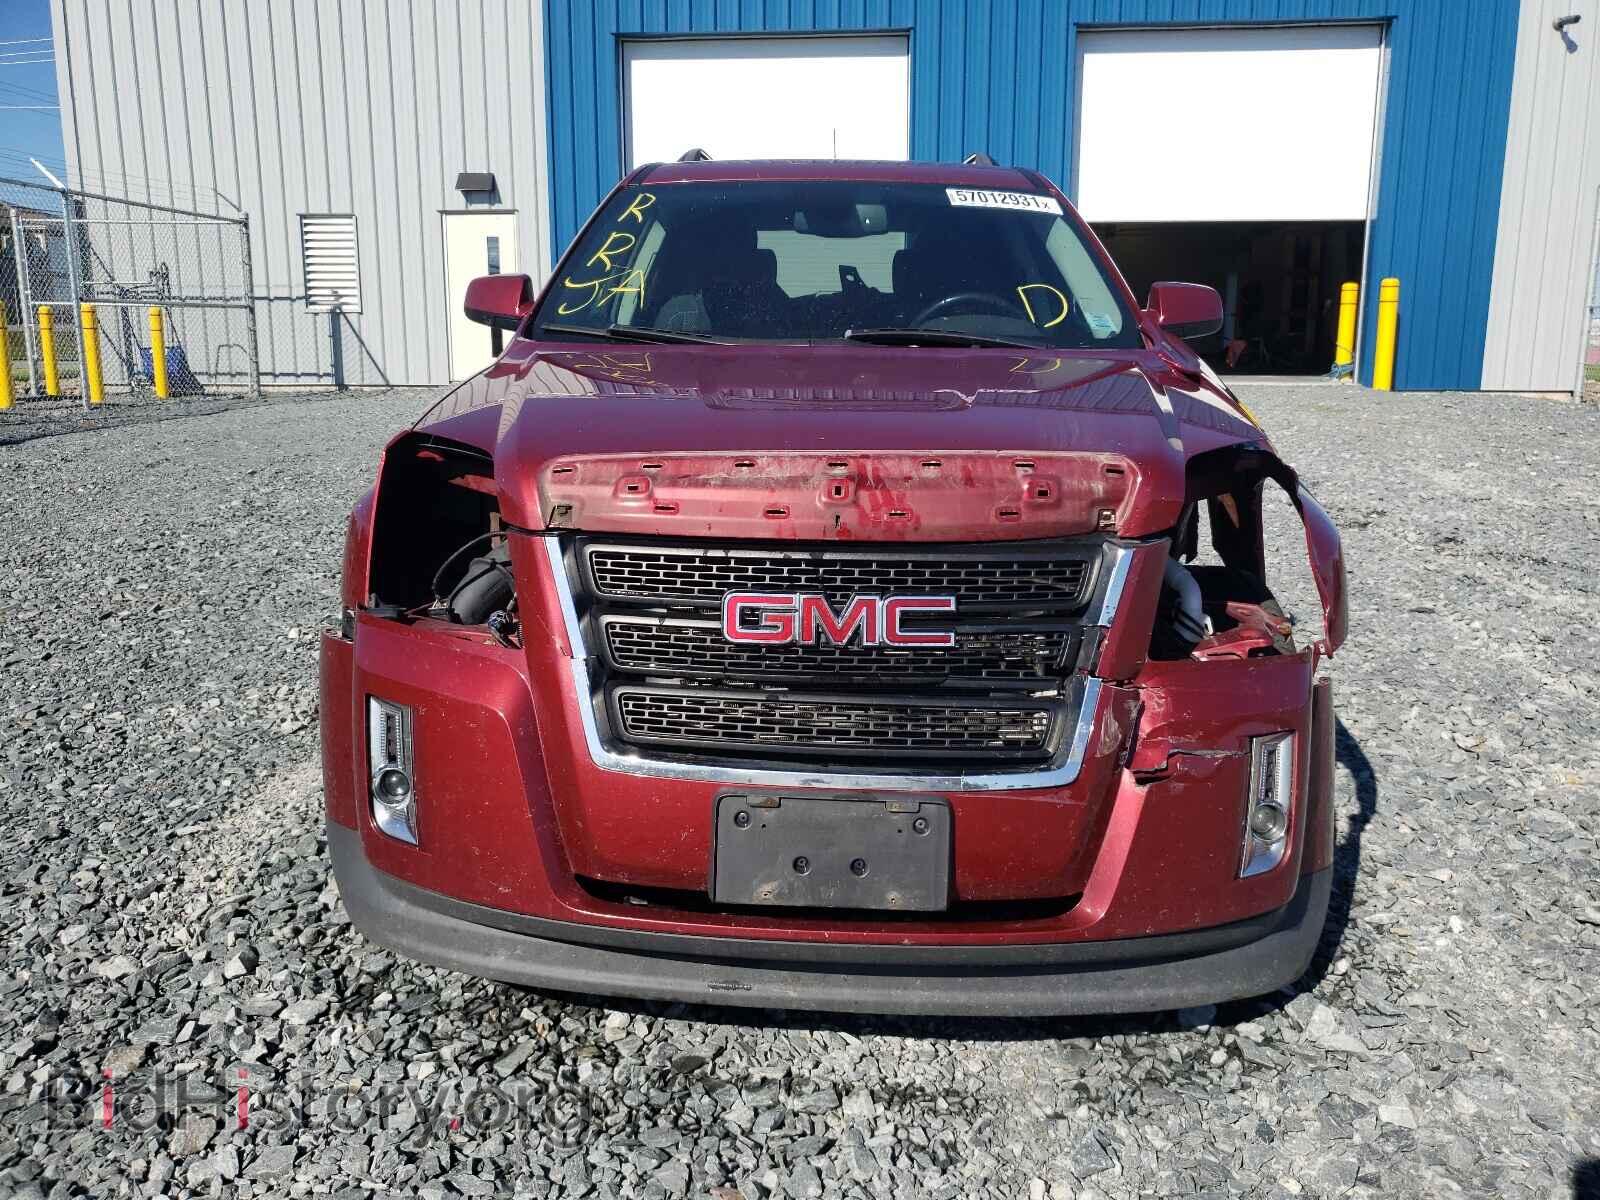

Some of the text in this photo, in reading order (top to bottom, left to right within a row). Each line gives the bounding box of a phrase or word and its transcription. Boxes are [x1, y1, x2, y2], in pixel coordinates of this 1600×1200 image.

[618, 193, 656, 223] R
[586, 232, 635, 272] R
[1018, 284, 1068, 328] D
[722, 592, 956, 647] GMC
